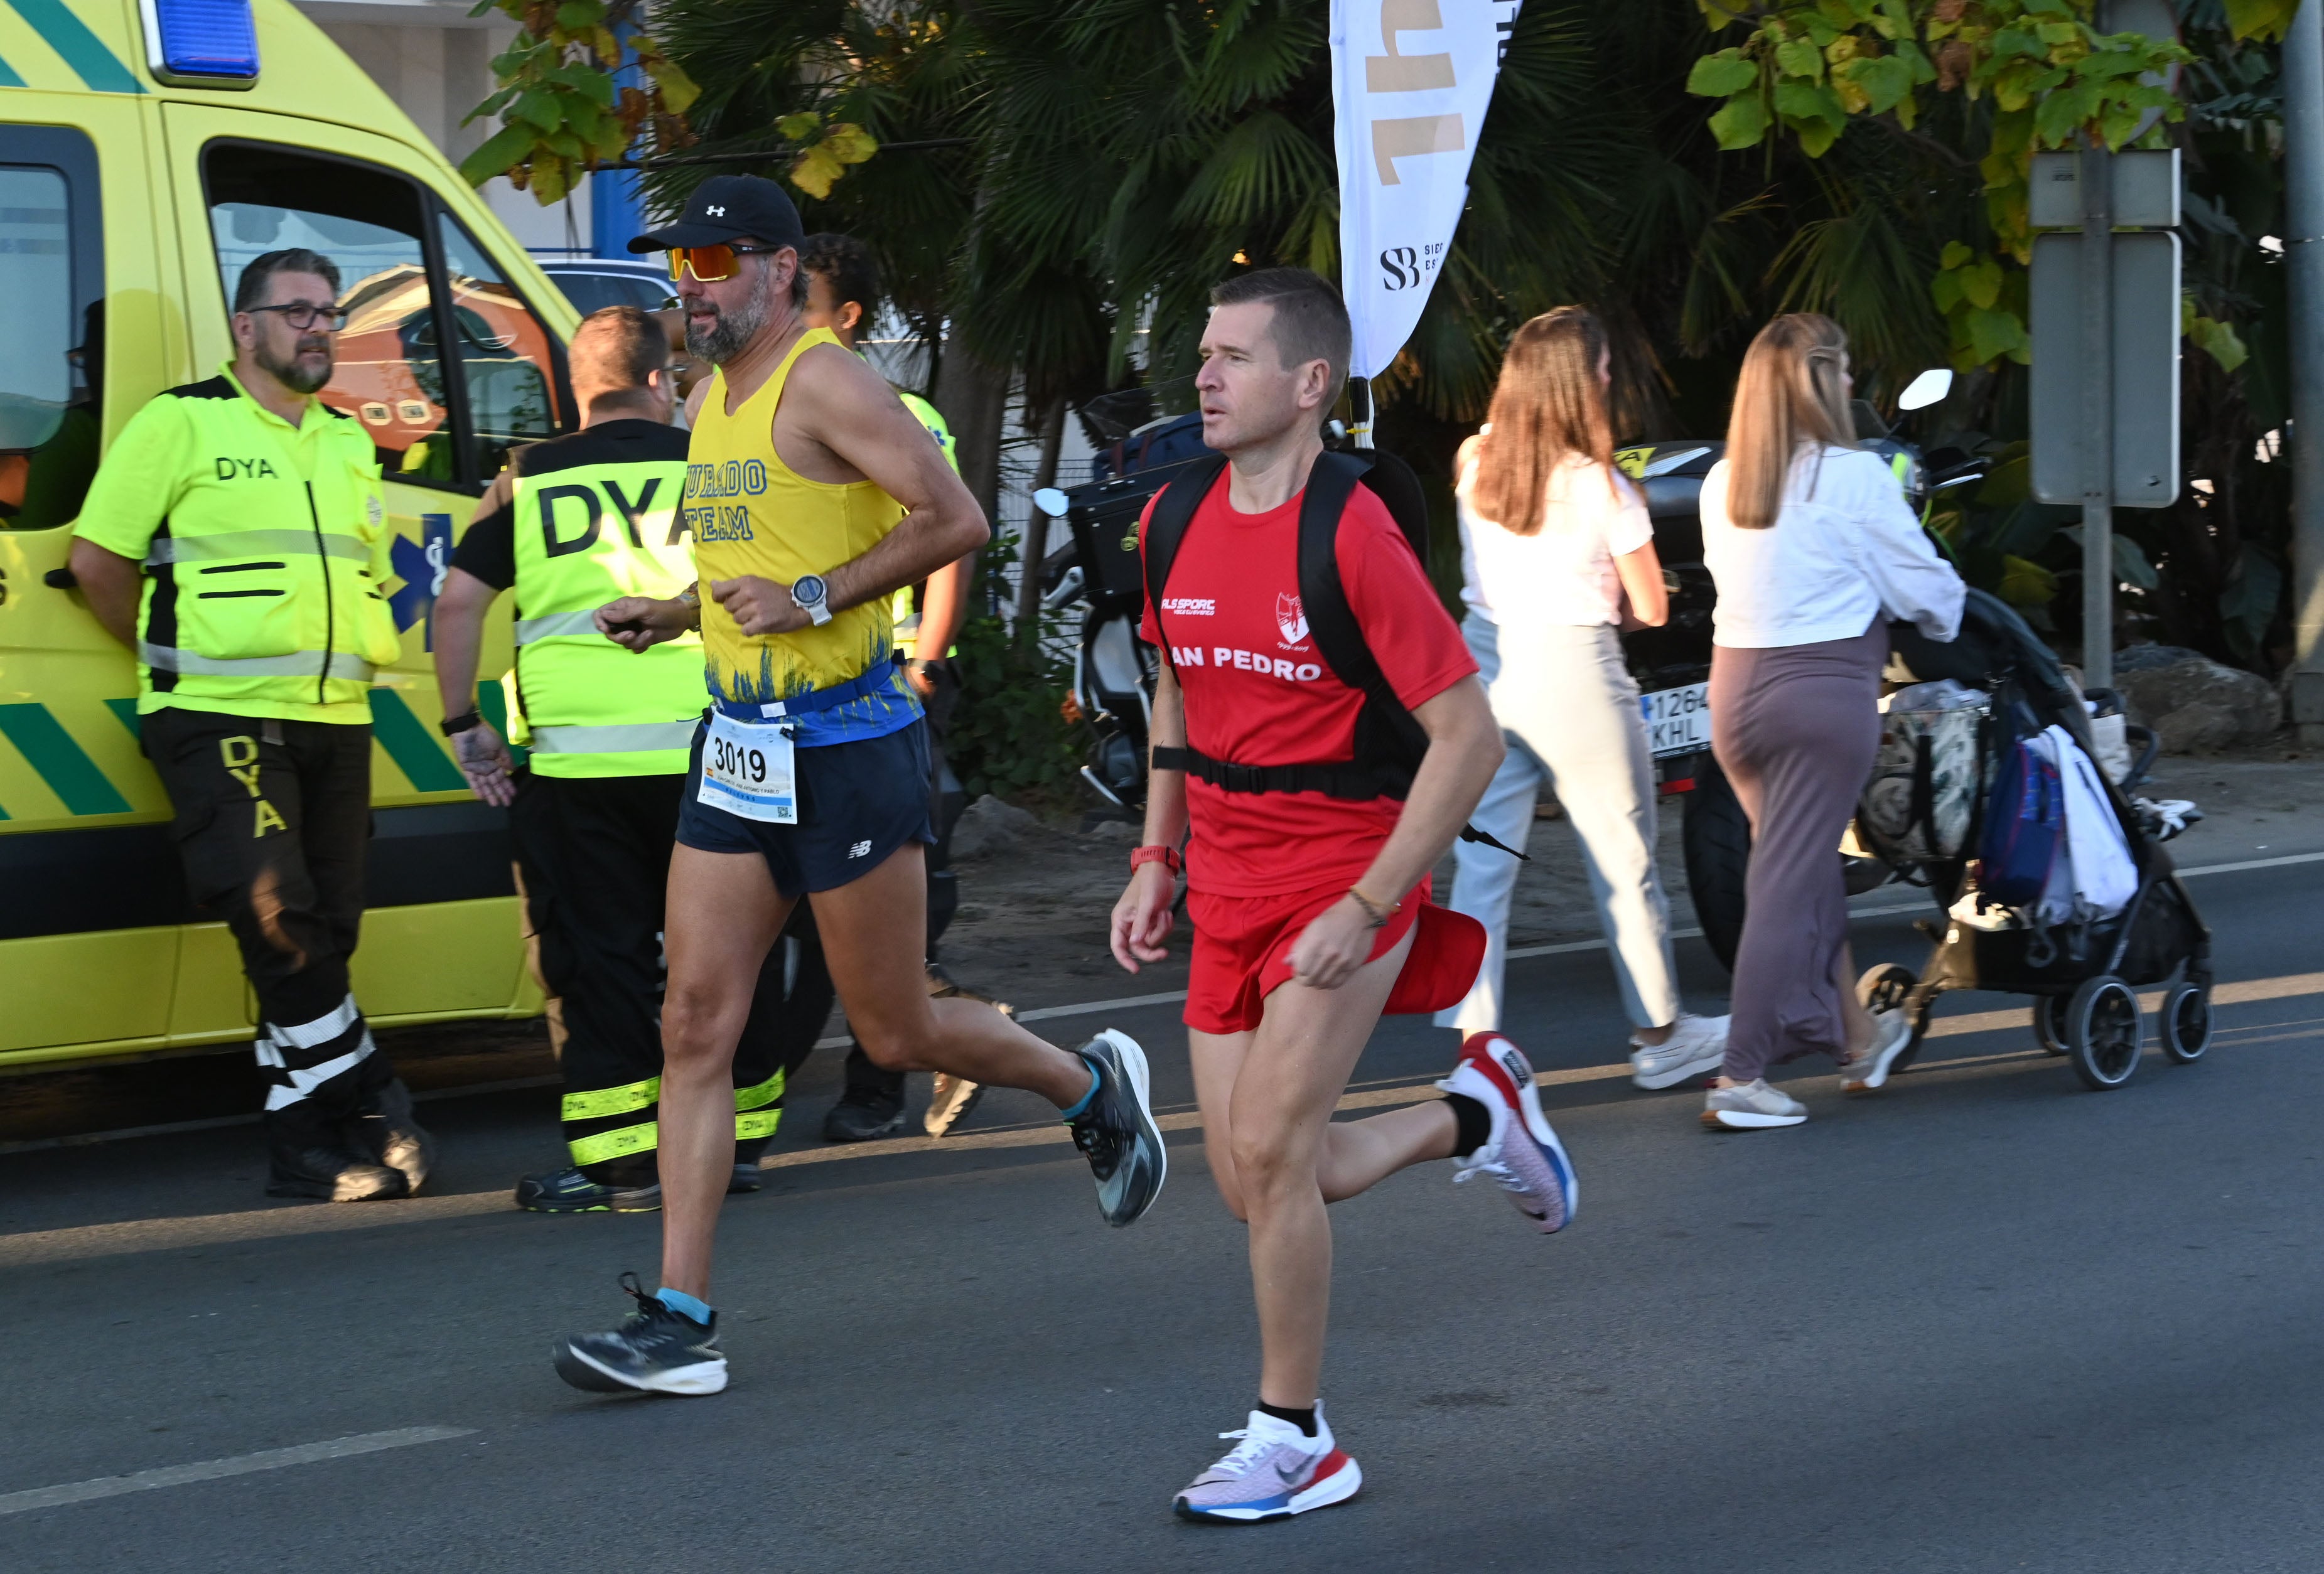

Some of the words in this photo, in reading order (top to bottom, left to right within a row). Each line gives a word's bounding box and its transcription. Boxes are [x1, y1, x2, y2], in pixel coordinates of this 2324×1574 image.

[214, 457, 280, 481] DYA
[687, 459, 767, 499] URADO
[684, 505, 754, 543] TEAM
[1172, 646, 1205, 667] AN
[1213, 647, 1321, 682] PEDRO
[1652, 718, 1701, 748] KHL
[715, 737, 766, 783] 3019
[220, 736, 288, 838] DYA
